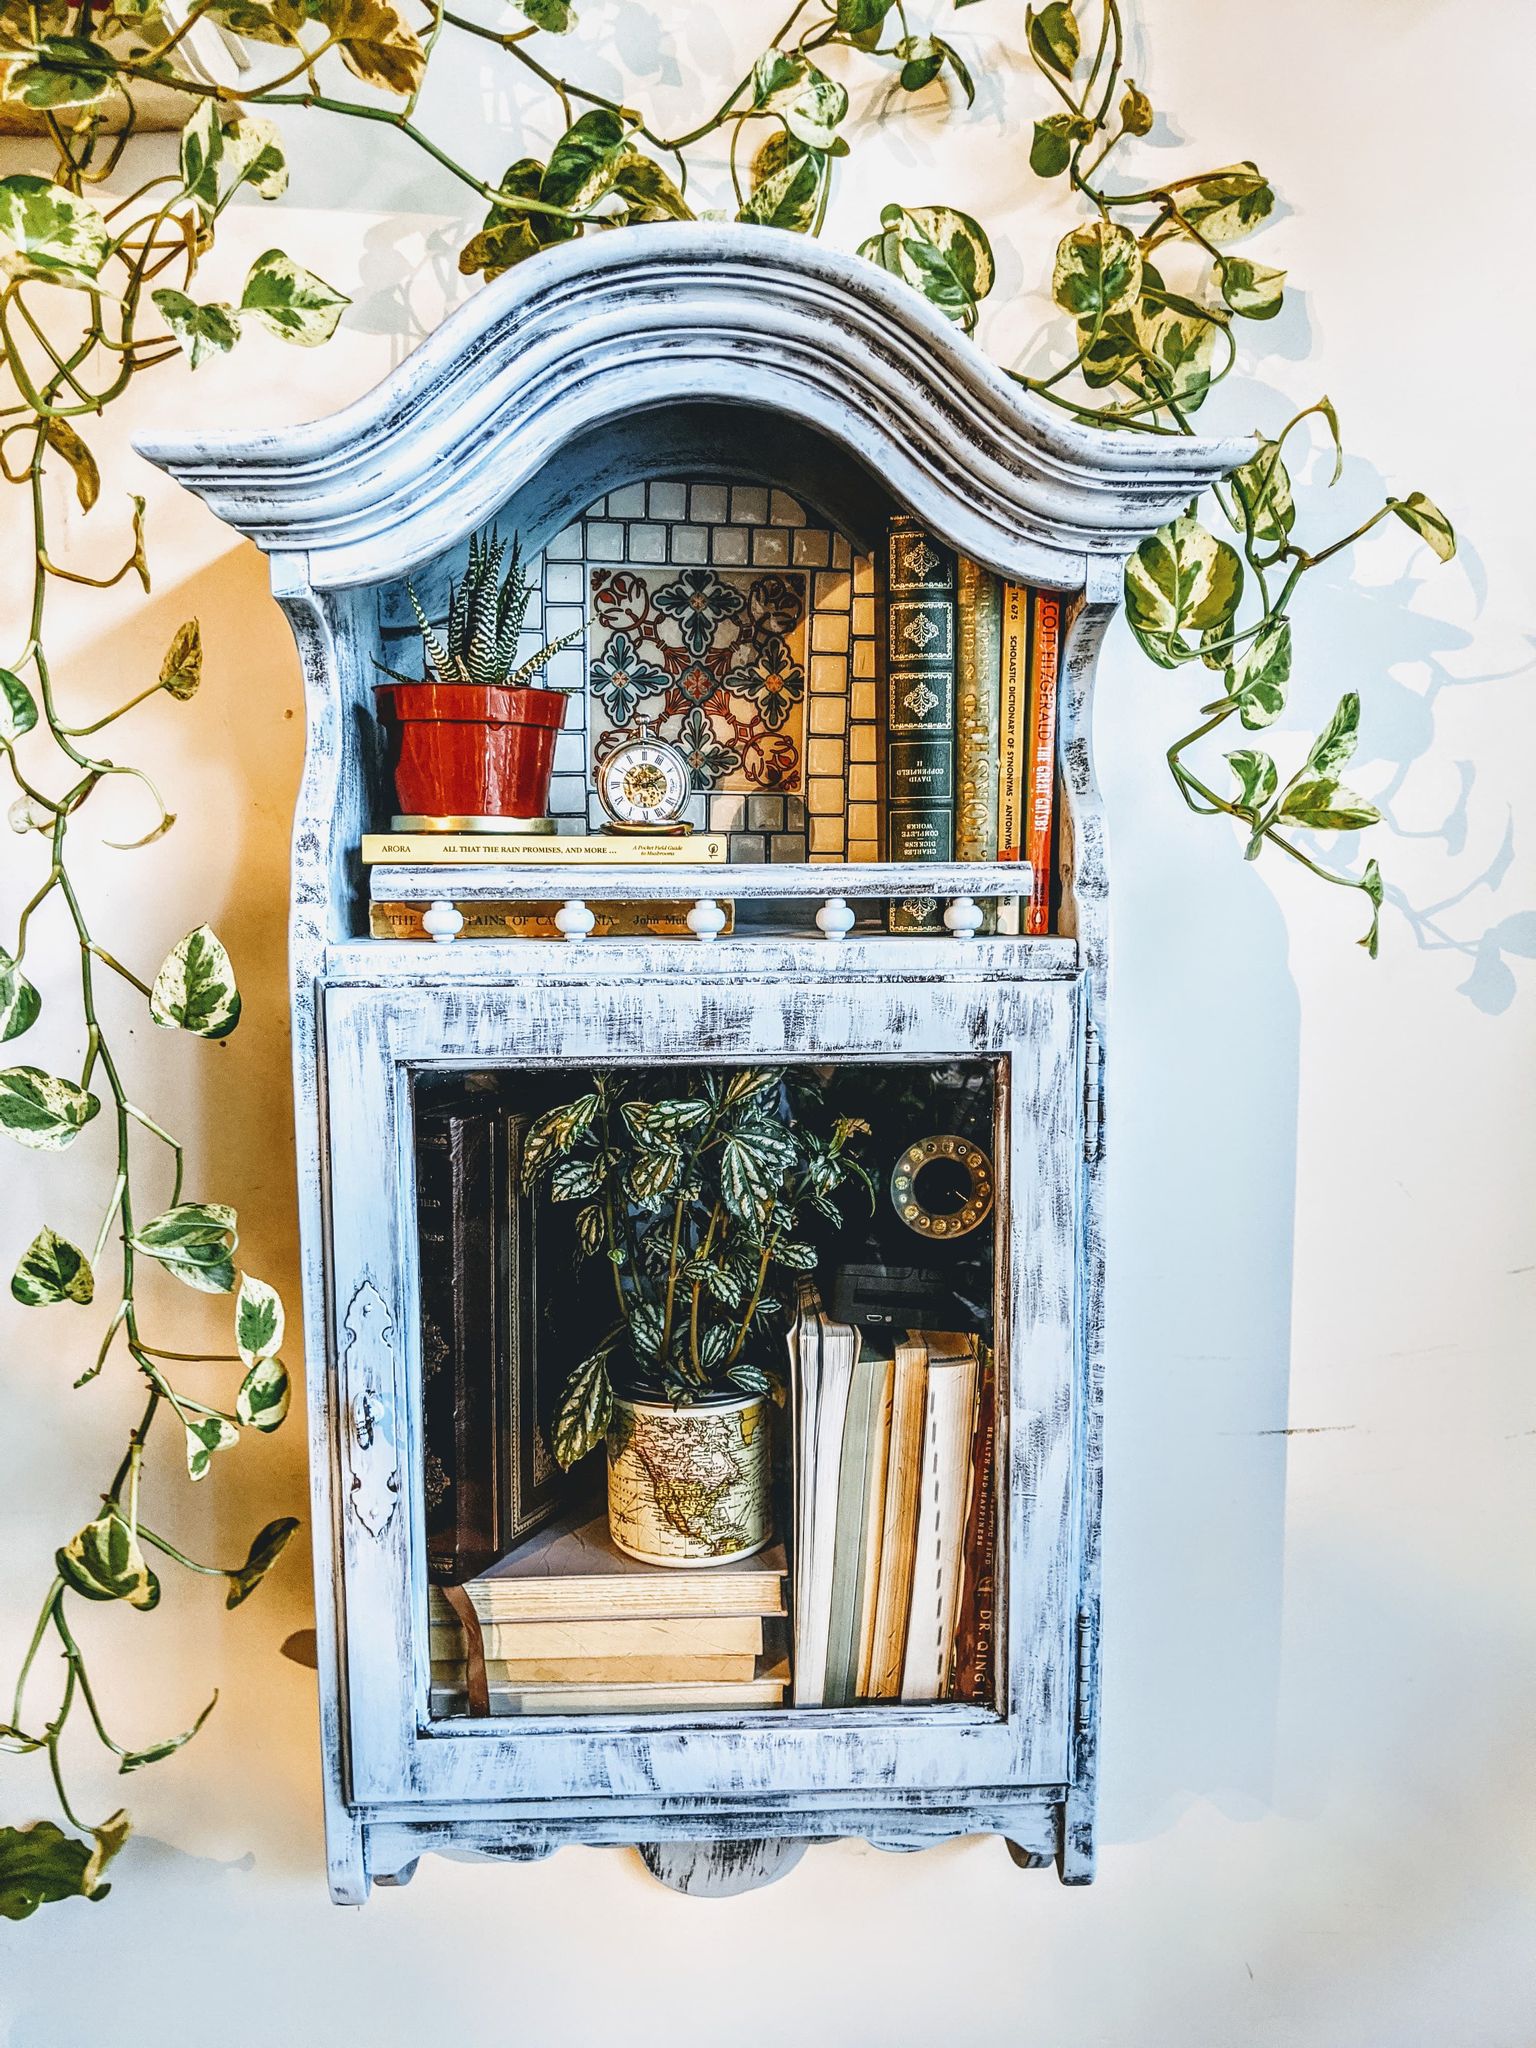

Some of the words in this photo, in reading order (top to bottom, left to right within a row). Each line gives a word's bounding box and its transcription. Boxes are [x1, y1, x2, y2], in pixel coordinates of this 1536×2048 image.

[1011, 591, 1019, 602] TK
[1010, 604, 1018, 620] 675
[1009, 635, 1017, 684] SCHOLASTIC
[1038, 651, 1057, 741] FITZGERALD
[1007, 685, 1016, 738] DICTIONARY
[1007, 739, 1014, 749] OF
[1036, 745, 1050, 763] THE
[896, 768, 944, 776] COPPERFIELD
[1006, 751, 1014, 797] SYNONYMS
[1035, 765, 1050, 796] GREAT
[1004, 804, 1013, 850] ANTONYMS
[1034, 798, 1050, 832] GATSBY
[381, 845, 411, 853] ARORA
[522, 847, 563, 855] PROMISES,
[389, 915, 418, 926] THE
[512, 915, 529, 926] OF
[632, 914, 660, 926] John
[984, 1426, 993, 1464] HEALTH
[977, 1491, 988, 1546] HAPPINESS
[978, 1610, 991, 1635] DR.
[974, 1641, 989, 1682] QING
